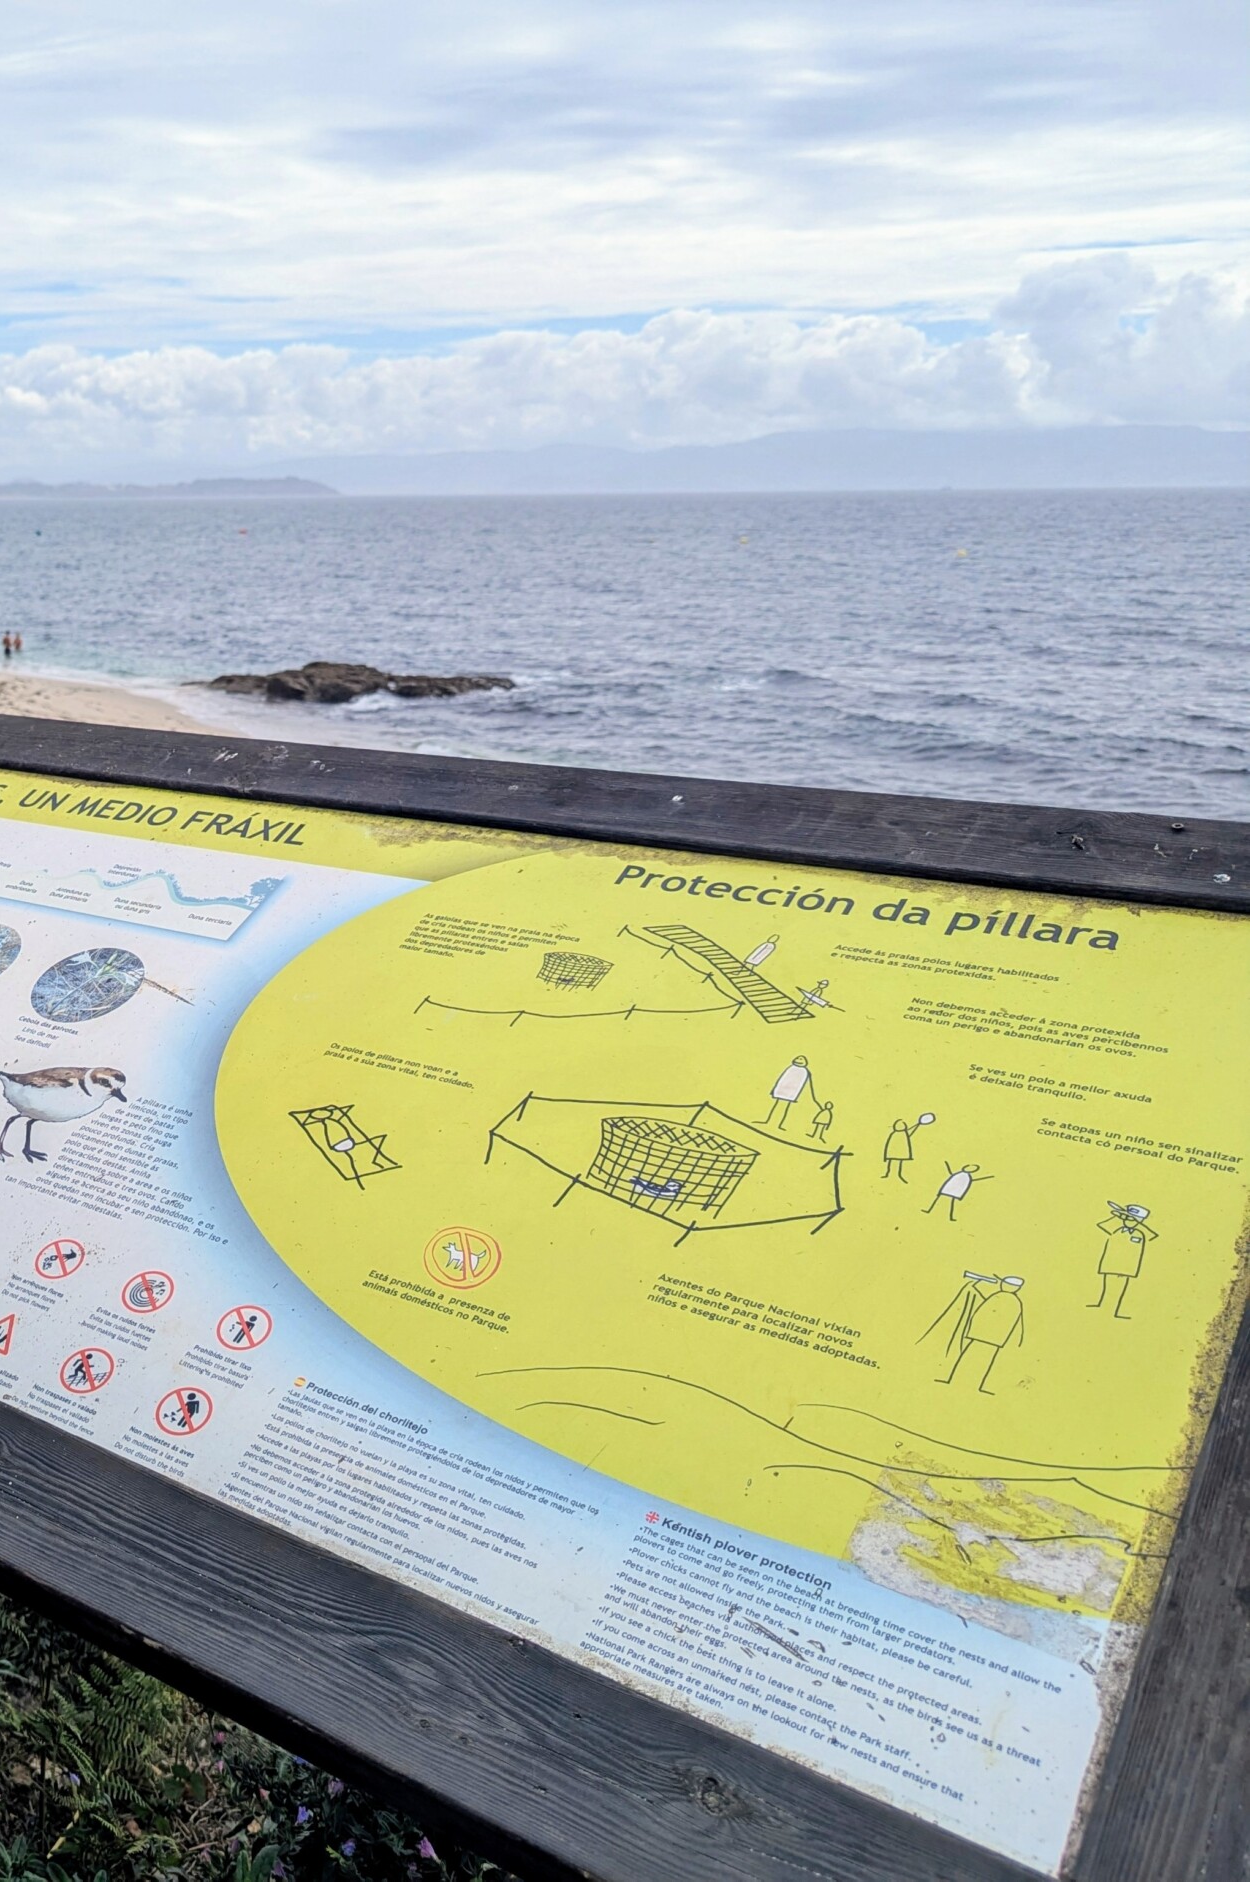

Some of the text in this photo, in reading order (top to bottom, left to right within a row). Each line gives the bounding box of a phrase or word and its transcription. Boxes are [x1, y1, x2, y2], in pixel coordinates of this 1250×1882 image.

[18, 788, 72, 812] UN
[65, 796, 179, 827] MEDIO
[179, 810, 307, 846] FRÁXIL
[613, 864, 1120, 951] Protección da píllara
[834, 944, 873, 955] Accede
[887, 952, 921, 962] praias
[921, 957, 952, 967] polos
[954, 960, 995, 973] lugares
[996, 966, 1060, 982] habilitados
[839, 953, 885, 965] respecta
[901, 962, 933, 972] zonas
[933, 967, 997, 982] protexidas.
[911, 997, 934, 1007] Non
[935, 1001, 987, 1015] debemos
[989, 1009, 1037, 1023] acceder
[1049, 1020, 1079, 1030] zona
[1080, 1025, 1141, 1040] protexida
[957, 1013, 978, 1022] dos
[980, 1017, 1015, 1030] niños,
[1017, 1024, 1043, 1033] pois
[1045, 1028, 1059, 1036] as
[1061, 1031, 1090, 1041] aves
[1091, 1036, 1169, 1054] percibennos
[322, 1050, 346, 1060] praia
[359, 1058, 376, 1067] súa
[375, 1062, 397, 1072] zona
[398, 1067, 419, 1078] vital,
[421, 1072, 438, 1081] ten
[438, 1076, 475, 1090] coidado.
[968, 1063, 984, 1073] Se
[987, 1068, 1007, 1077] ves
[1009, 1072, 1026, 1080] un
[1027, 1075, 1056, 1086] polo
[1069, 1083, 1111, 1096] mellor
[1113, 1091, 1153, 1104] axuda
[968, 1073, 1087, 1102] é deixalo tranquilo.
[1036, 1128, 1240, 1175] contacta có persoal do Parque.
[1040, 1117, 1244, 1164] Se atopas un niño sen sinalizar
[4, 1174, 123, 1221] tan importante evitar molestalas.
[361, 1280, 510, 1335] animais domésticos no Parque.
[368, 1269, 511, 1322] Está prohibida a presenza de
[652, 1284, 854, 1349] regularmente para localizar novos
[657, 1273, 704, 1293] Axentes
[706, 1287, 722, 1298] do
[723, 1291, 766, 1310] Parque
[767, 1304, 821, 1327] Nacional
[193, 1344, 252, 1372] Prohibido tirar lixo
[305, 1381, 429, 1435] Protección del chorlitejo
[122, 1446, 135, 1456] not
[134, 1451, 157, 1465] disturb
[156, 1461, 169, 1473] the
[168, 1465, 185, 1478] birds
[128, 1425, 143, 1436] Non
[142, 1432, 171, 1449] molestes
[178, 1448, 195, 1459] aves
[713, 1539, 759, 1562] plover
[759, 1557, 832, 1591] protection
[633, 1534, 956, 1666] plovers to come and go freely, protecting them from larger predators.
[579, 1640, 724, 1710] appropriate measures are taken.
